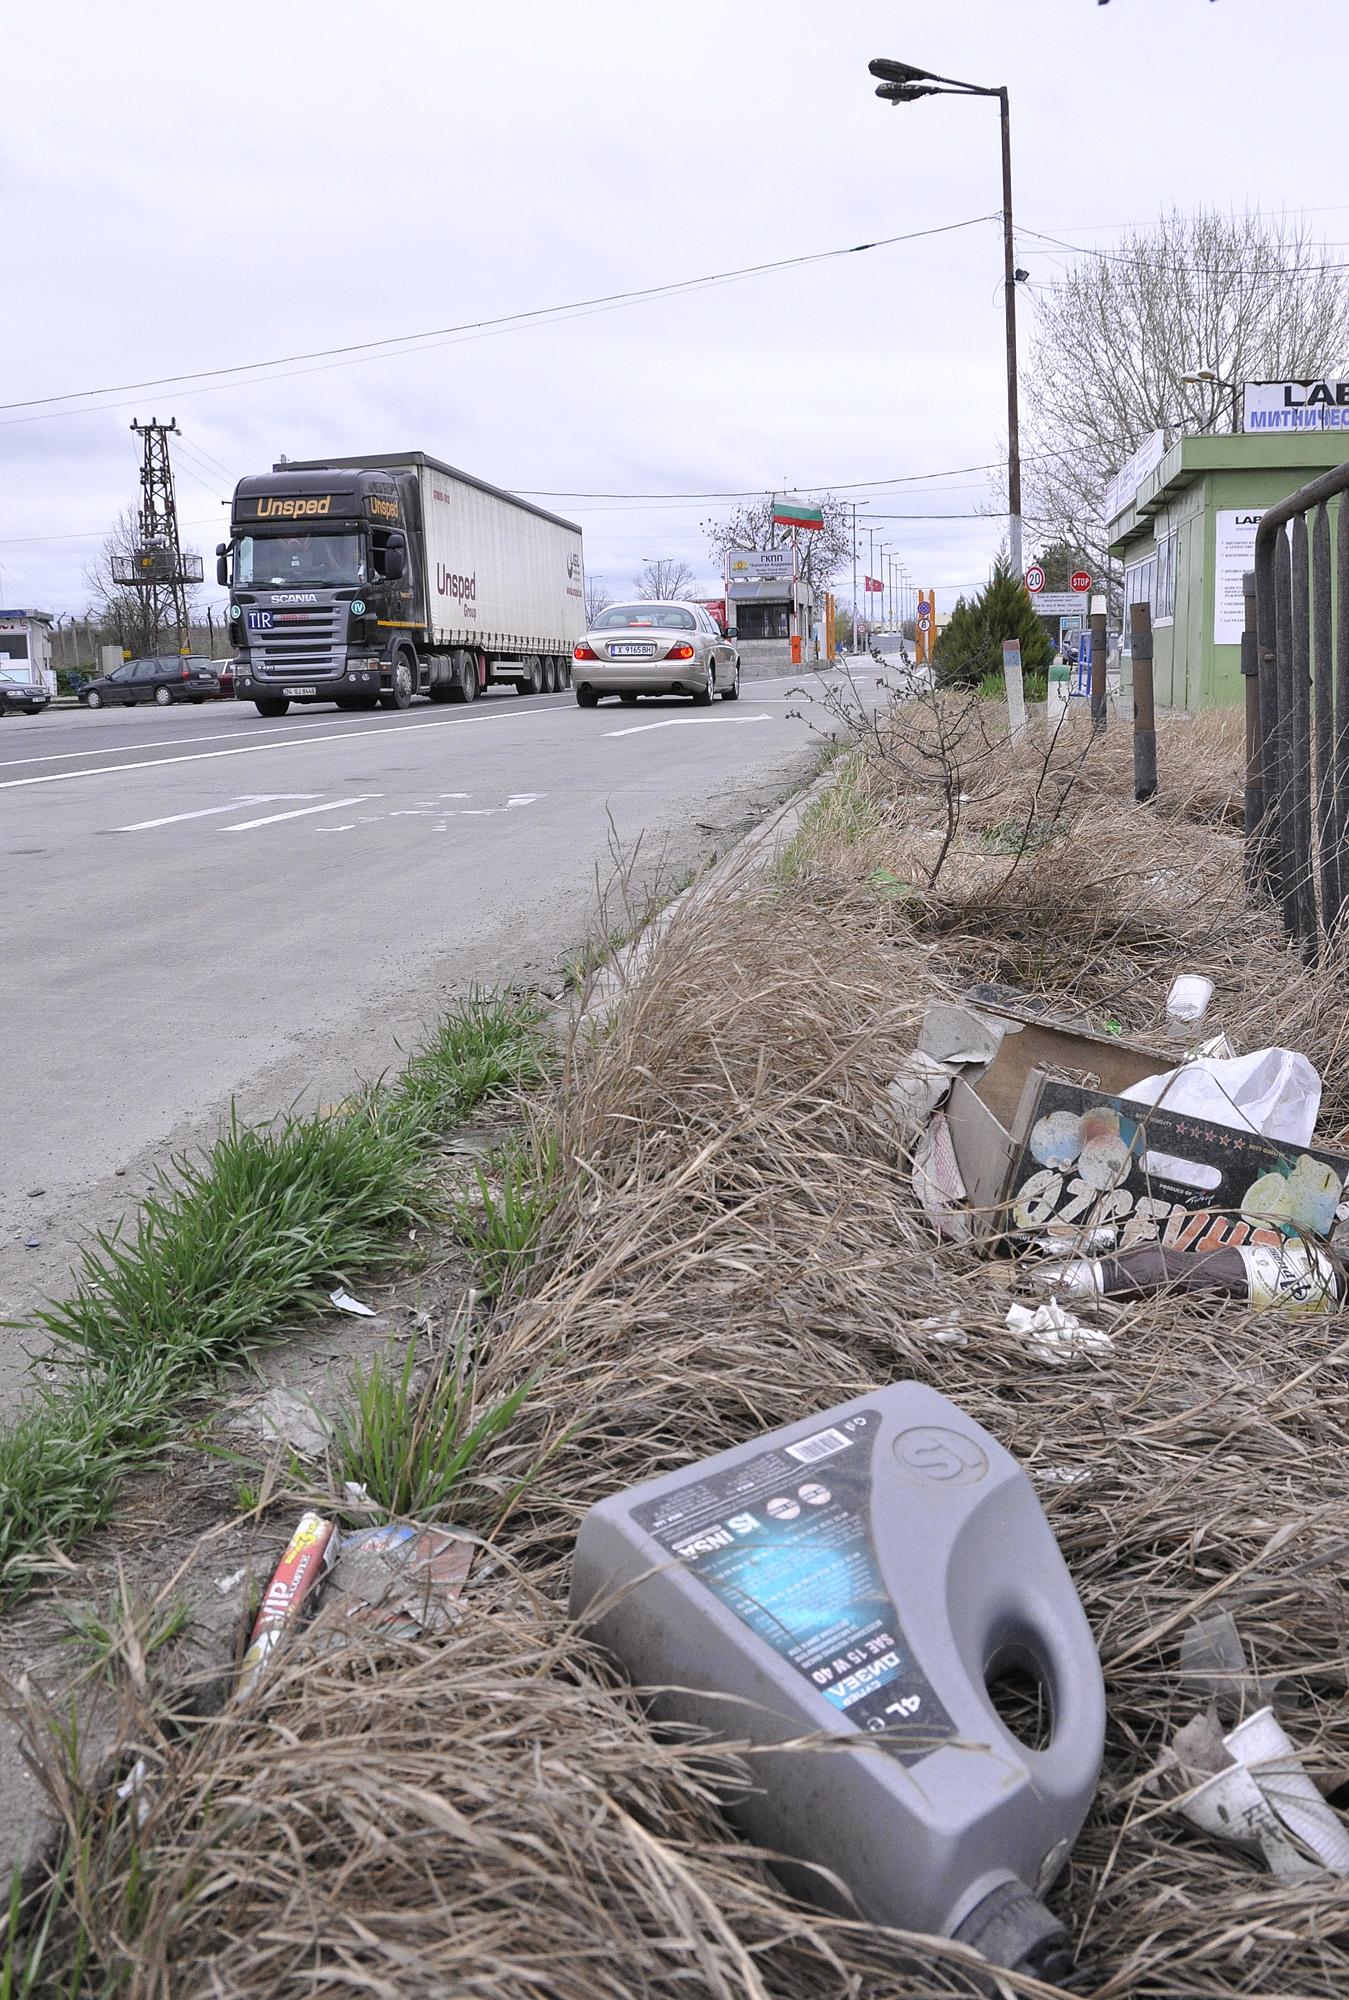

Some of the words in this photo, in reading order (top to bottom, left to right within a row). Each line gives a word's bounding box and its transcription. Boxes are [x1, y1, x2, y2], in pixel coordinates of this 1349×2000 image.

[257, 495, 331, 518] Unsped
[369, 496, 399, 519] Unsped
[436, 562, 476, 605] Unsped
[1029, 573, 1040, 586] 20
[1073, 577, 1090, 587] STOP
[271, 594, 318, 604] SCANIA
[354, 603, 363, 612] IV
[249, 612, 272, 628] TIR
[463, 604, 477, 621] Group
[1159, 1183, 1184, 1195] PRODUCE
[677, 1529, 735, 1558] INSA
[864, 1633, 895, 1654] SAE
[846, 1648, 868, 1665] 15
[811, 1666, 834, 1684] 40
[827, 1651, 901, 1697] ДИЗЕЛ
[831, 1658, 852, 1675] W
[842, 1679, 882, 1707] СУПЕР
[885, 1694, 921, 1718] 4L
